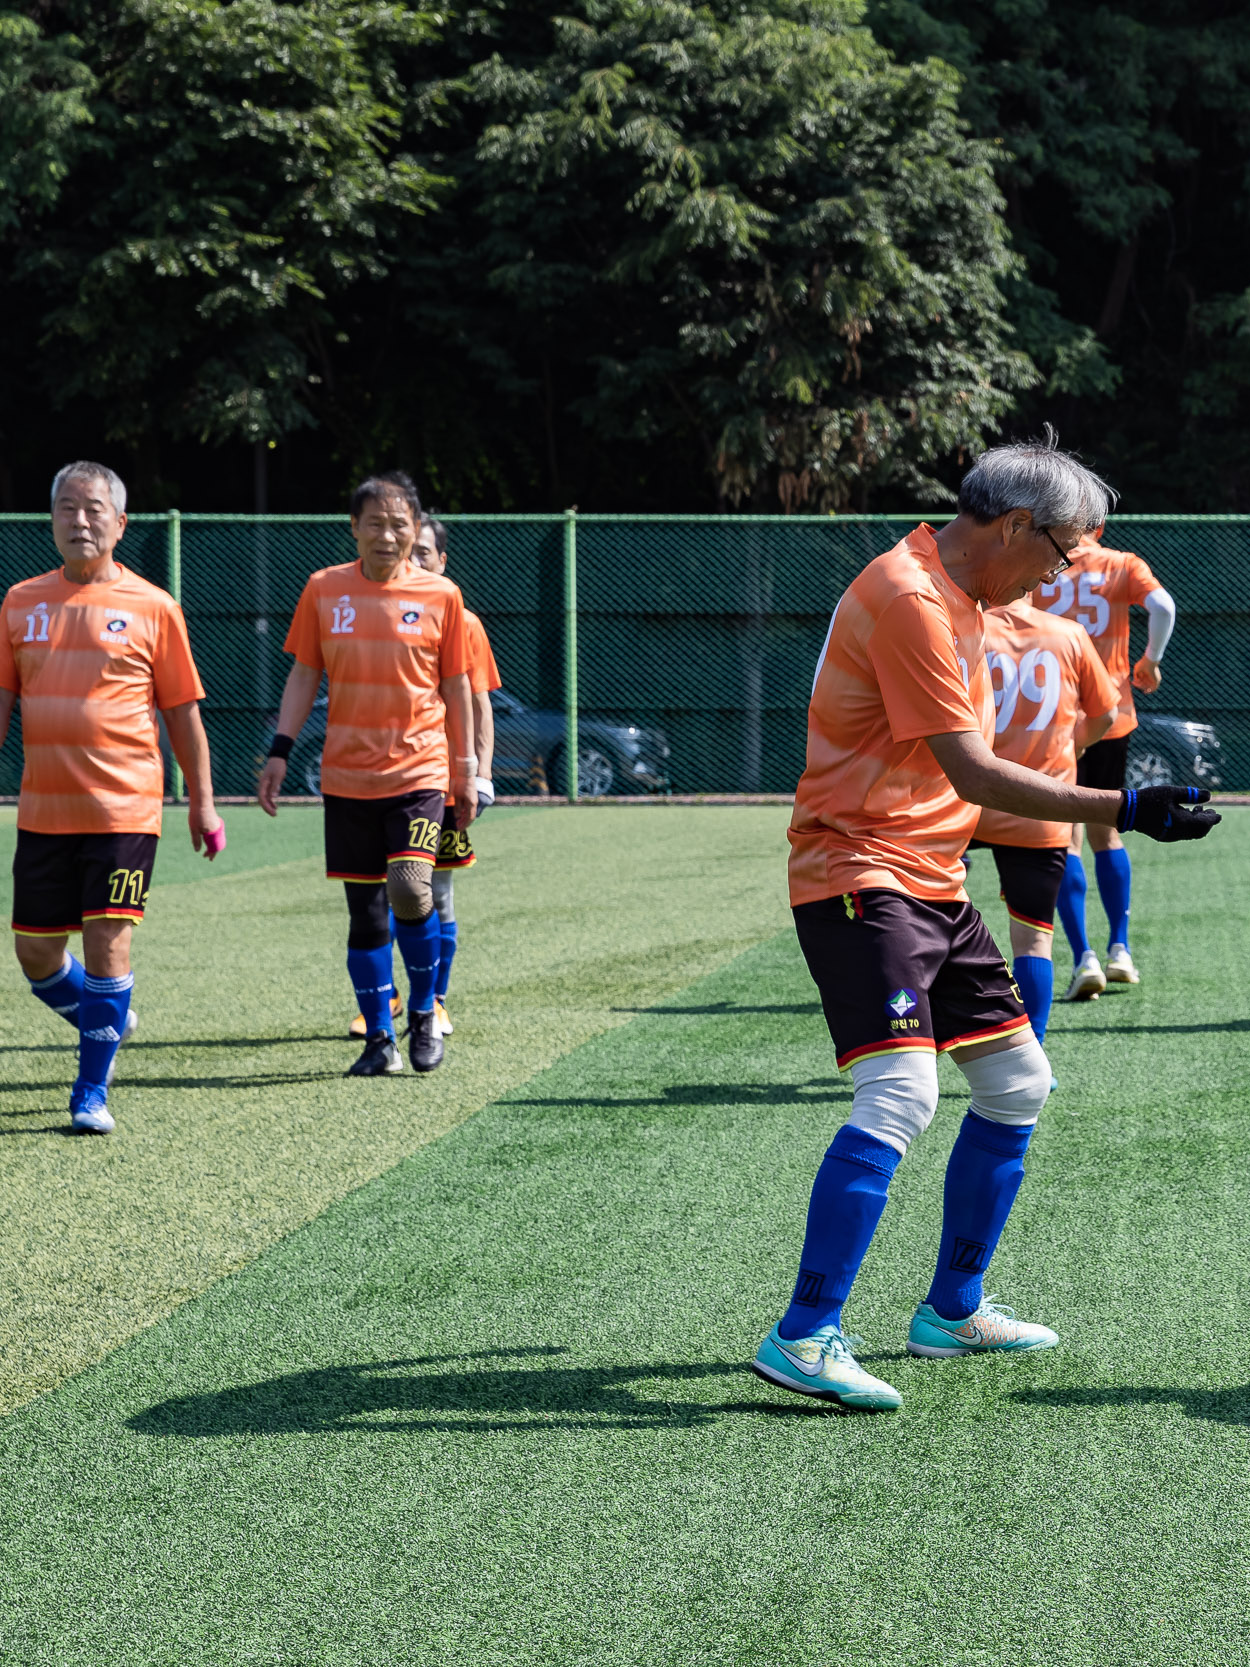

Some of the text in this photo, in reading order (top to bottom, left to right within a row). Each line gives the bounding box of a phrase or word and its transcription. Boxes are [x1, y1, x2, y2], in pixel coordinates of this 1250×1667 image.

[331, 606, 356, 634] 12
[1041, 572, 1111, 638] 25
[23, 614, 49, 642] 11
[986, 648, 1061, 734] 99
[408, 817, 442, 853] 12
[108, 868, 144, 906] 11
[908, 1018, 920, 1029] 70
